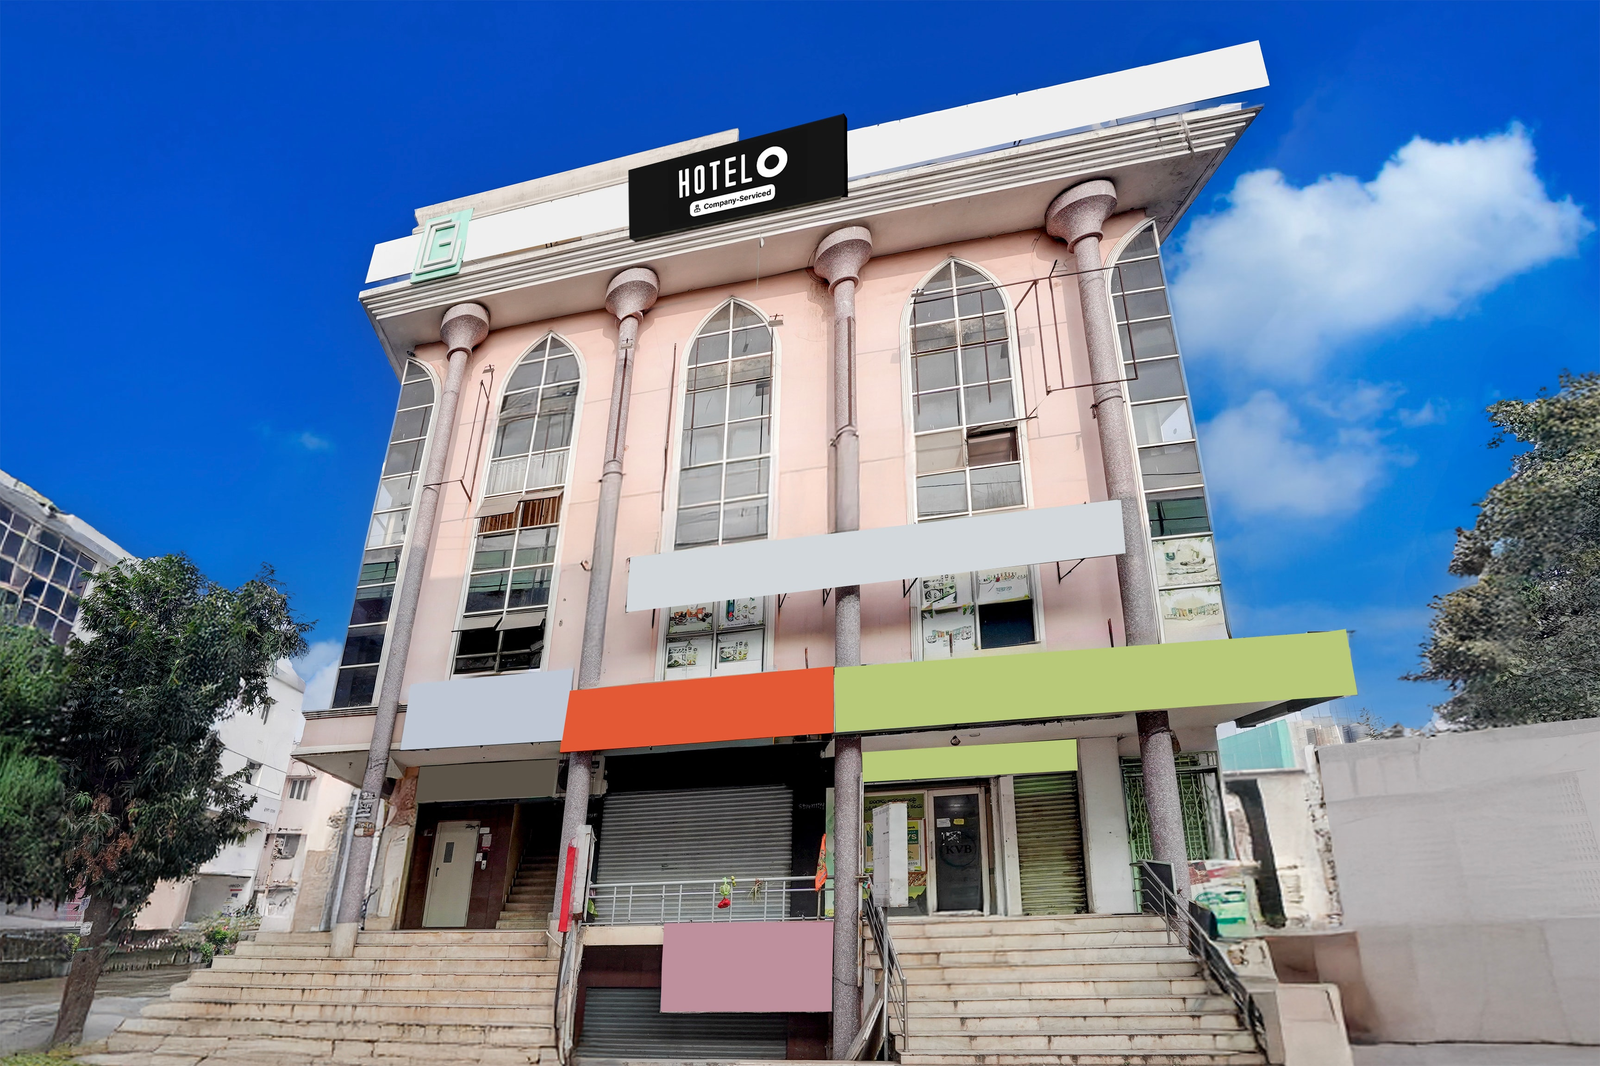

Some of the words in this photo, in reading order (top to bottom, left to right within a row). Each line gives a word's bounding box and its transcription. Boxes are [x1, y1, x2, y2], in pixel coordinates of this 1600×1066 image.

[678, 153, 753, 199] HOTEL
[703, 188, 772, 210] Company-Serviced
[946, 844, 972, 855] KVB
